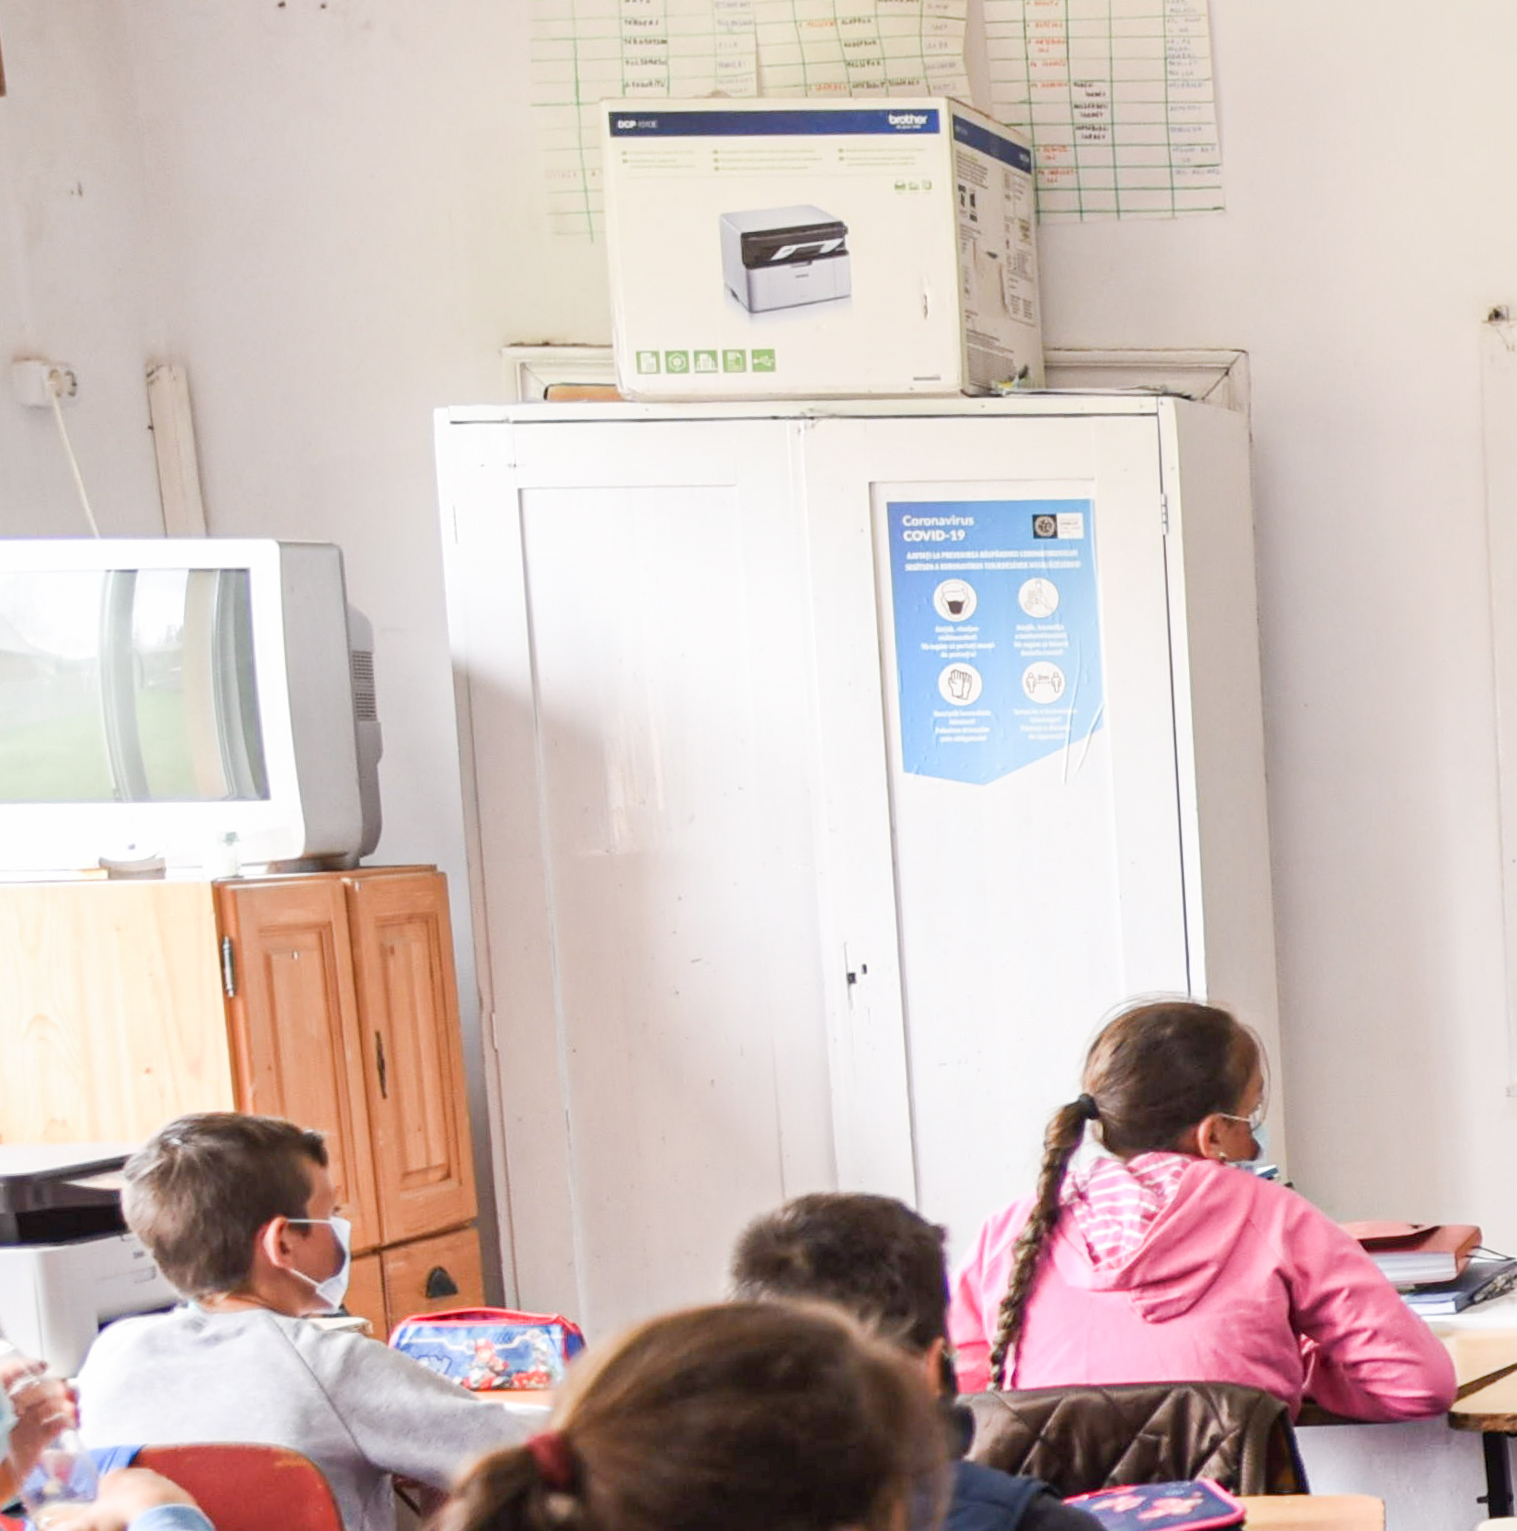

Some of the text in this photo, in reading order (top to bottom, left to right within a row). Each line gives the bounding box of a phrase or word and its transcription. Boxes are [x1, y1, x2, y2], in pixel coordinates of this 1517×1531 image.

[888, 113, 928, 126] brother
[902, 514, 975, 528] Coronavirus
[903, 529, 966, 542] COVID-19
